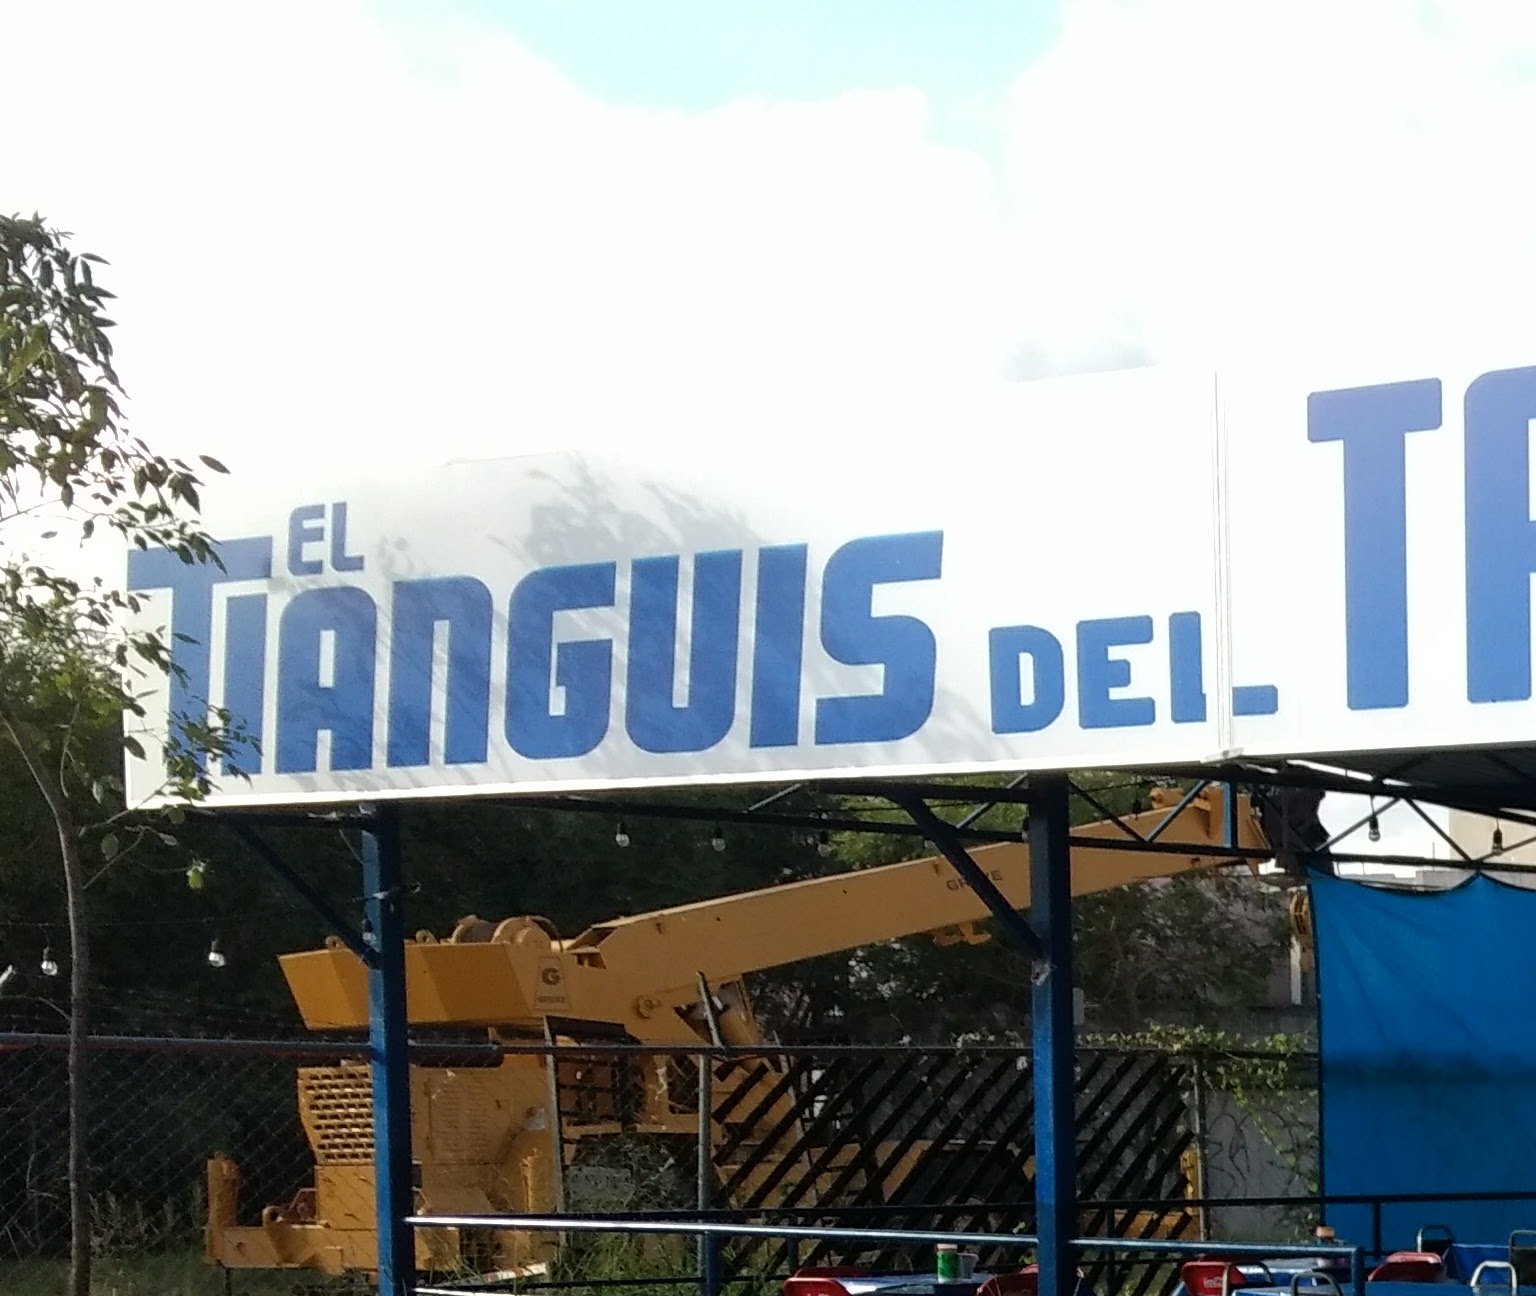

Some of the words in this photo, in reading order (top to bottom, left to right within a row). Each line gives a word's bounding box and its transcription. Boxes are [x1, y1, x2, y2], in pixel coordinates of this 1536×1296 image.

[287, 502, 364, 575] EL
[127, 530, 943, 788] TIANGUIS
[988, 611, 1278, 735] DEL
